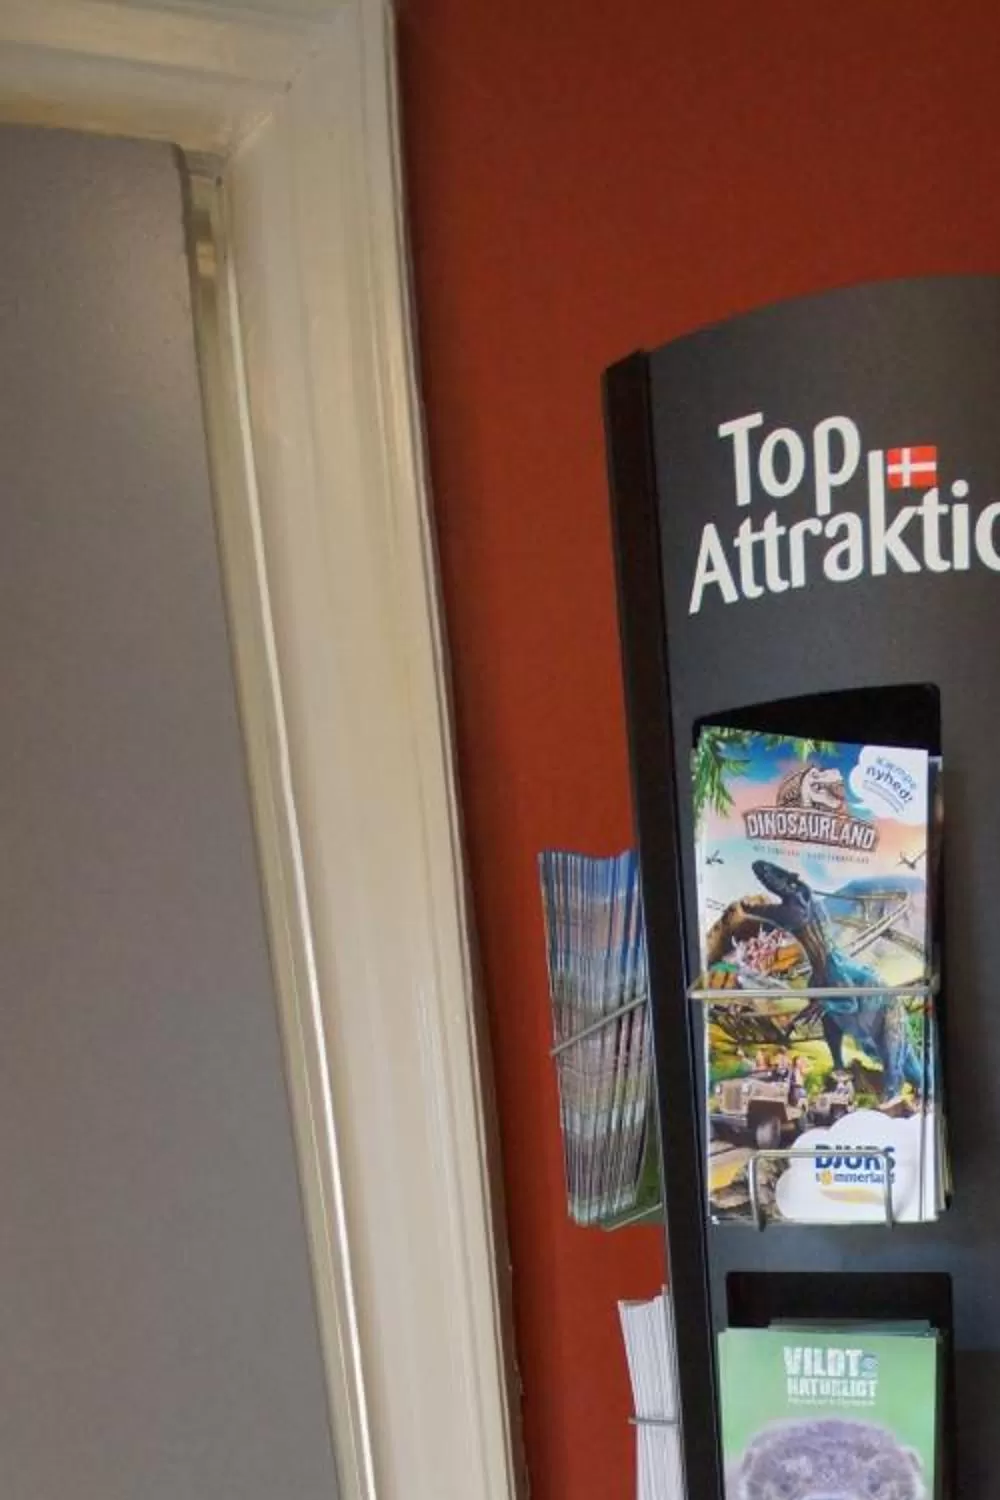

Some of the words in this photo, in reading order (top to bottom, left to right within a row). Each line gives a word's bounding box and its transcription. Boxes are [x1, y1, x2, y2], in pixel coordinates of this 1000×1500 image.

[717, 411, 861, 515] Top
[747, 810, 876, 850] DINOSAURLAND
[783, 1346, 864, 1377] VILDT
